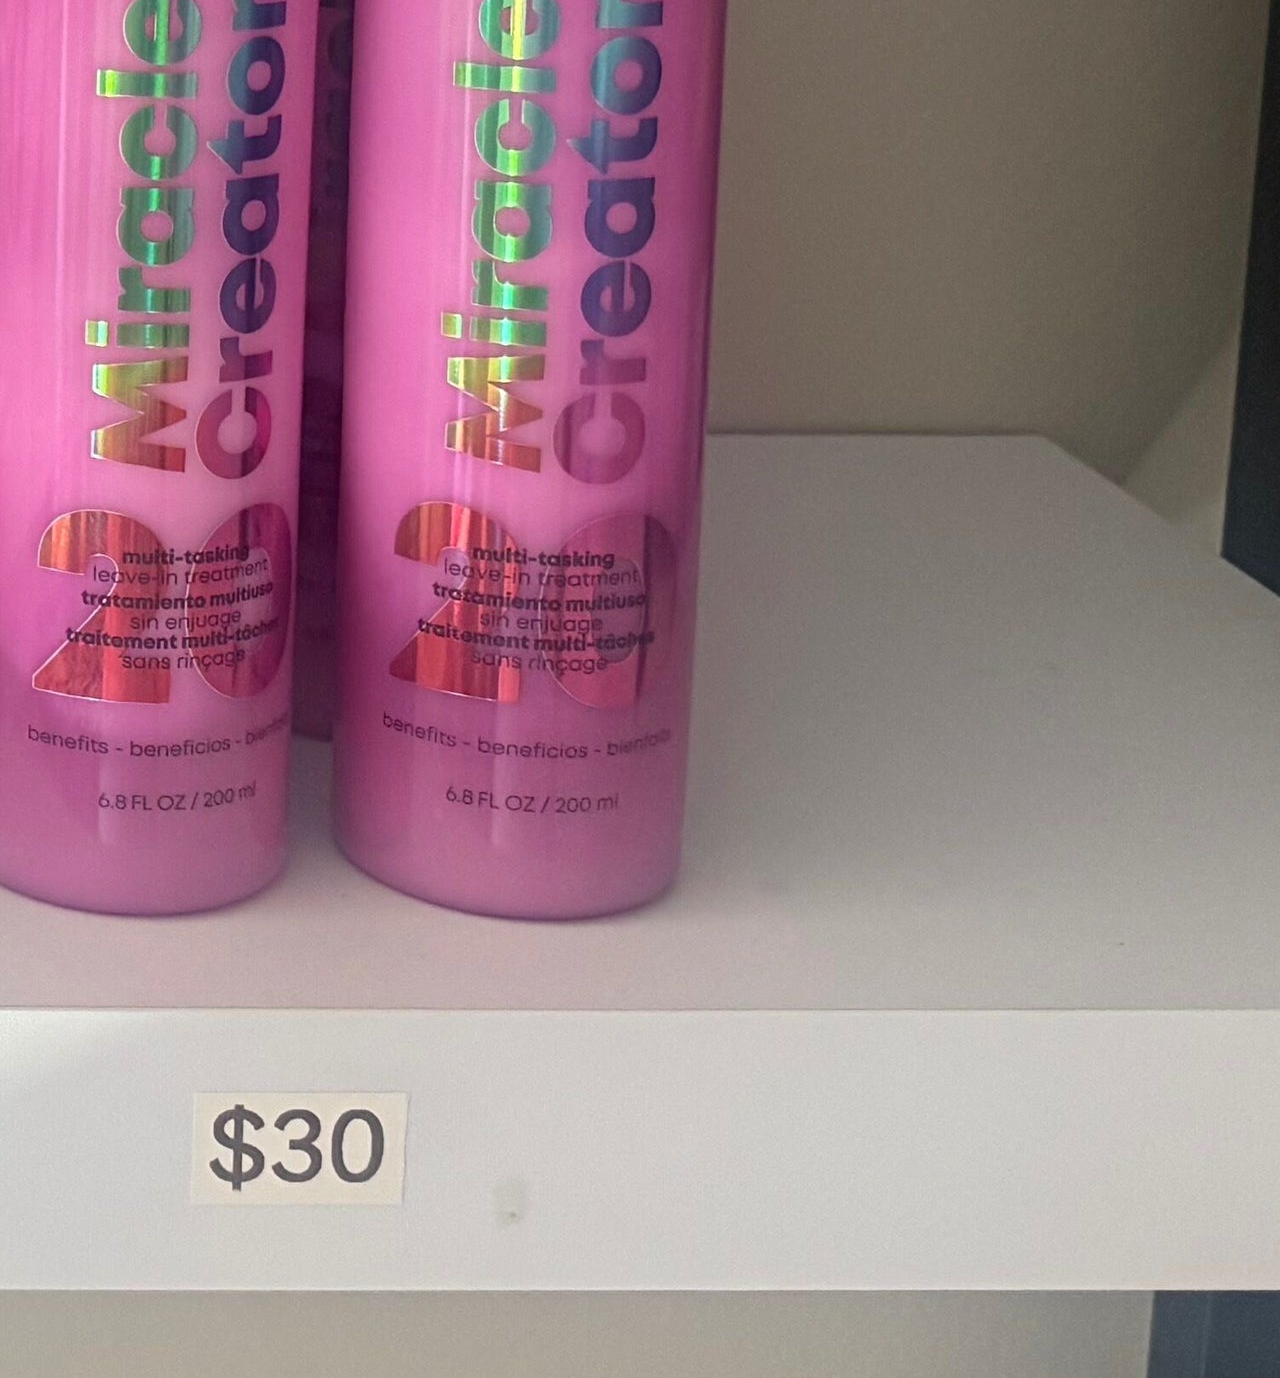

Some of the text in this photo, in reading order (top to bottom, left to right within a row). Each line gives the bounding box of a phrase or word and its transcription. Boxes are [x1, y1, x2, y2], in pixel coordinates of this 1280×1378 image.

[122, 544, 250, 566] multi-tasking
[472, 546, 616, 570] multi-tasking
[92, 557, 269, 586] leave-in treatment
[443, 557, 640, 588] leave-in treatment
[81, 581, 274, 610] tratamiento multiuso
[432, 581, 647, 612] tratamiento multiuso
[130, 610, 242, 633] sin enjuage
[417, 617, 530, 650] traitement
[480, 612, 604, 636] sin enjuage
[65, 626, 178, 650] traitement
[121, 653, 171, 670] sans
[470, 649, 522, 670] sans
[27, 724, 109, 755] benefits
[129, 737, 232, 758] beneficios
[382, 711, 457, 748] benefits
[477, 736, 588, 760] beneficios
[98, 792, 127, 810] 6.8
[131, 794, 153, 811] FL
[157, 794, 187, 811] OZ
[203, 787, 234, 808] 200
[445, 785, 474, 805] 6.8
[477, 791, 500, 810] FL
[505, 794, 536, 813] OZ
[555, 796, 592, 814] 200
[597, 792, 619, 812] ml
[208, 1103, 385, 1192] $30
